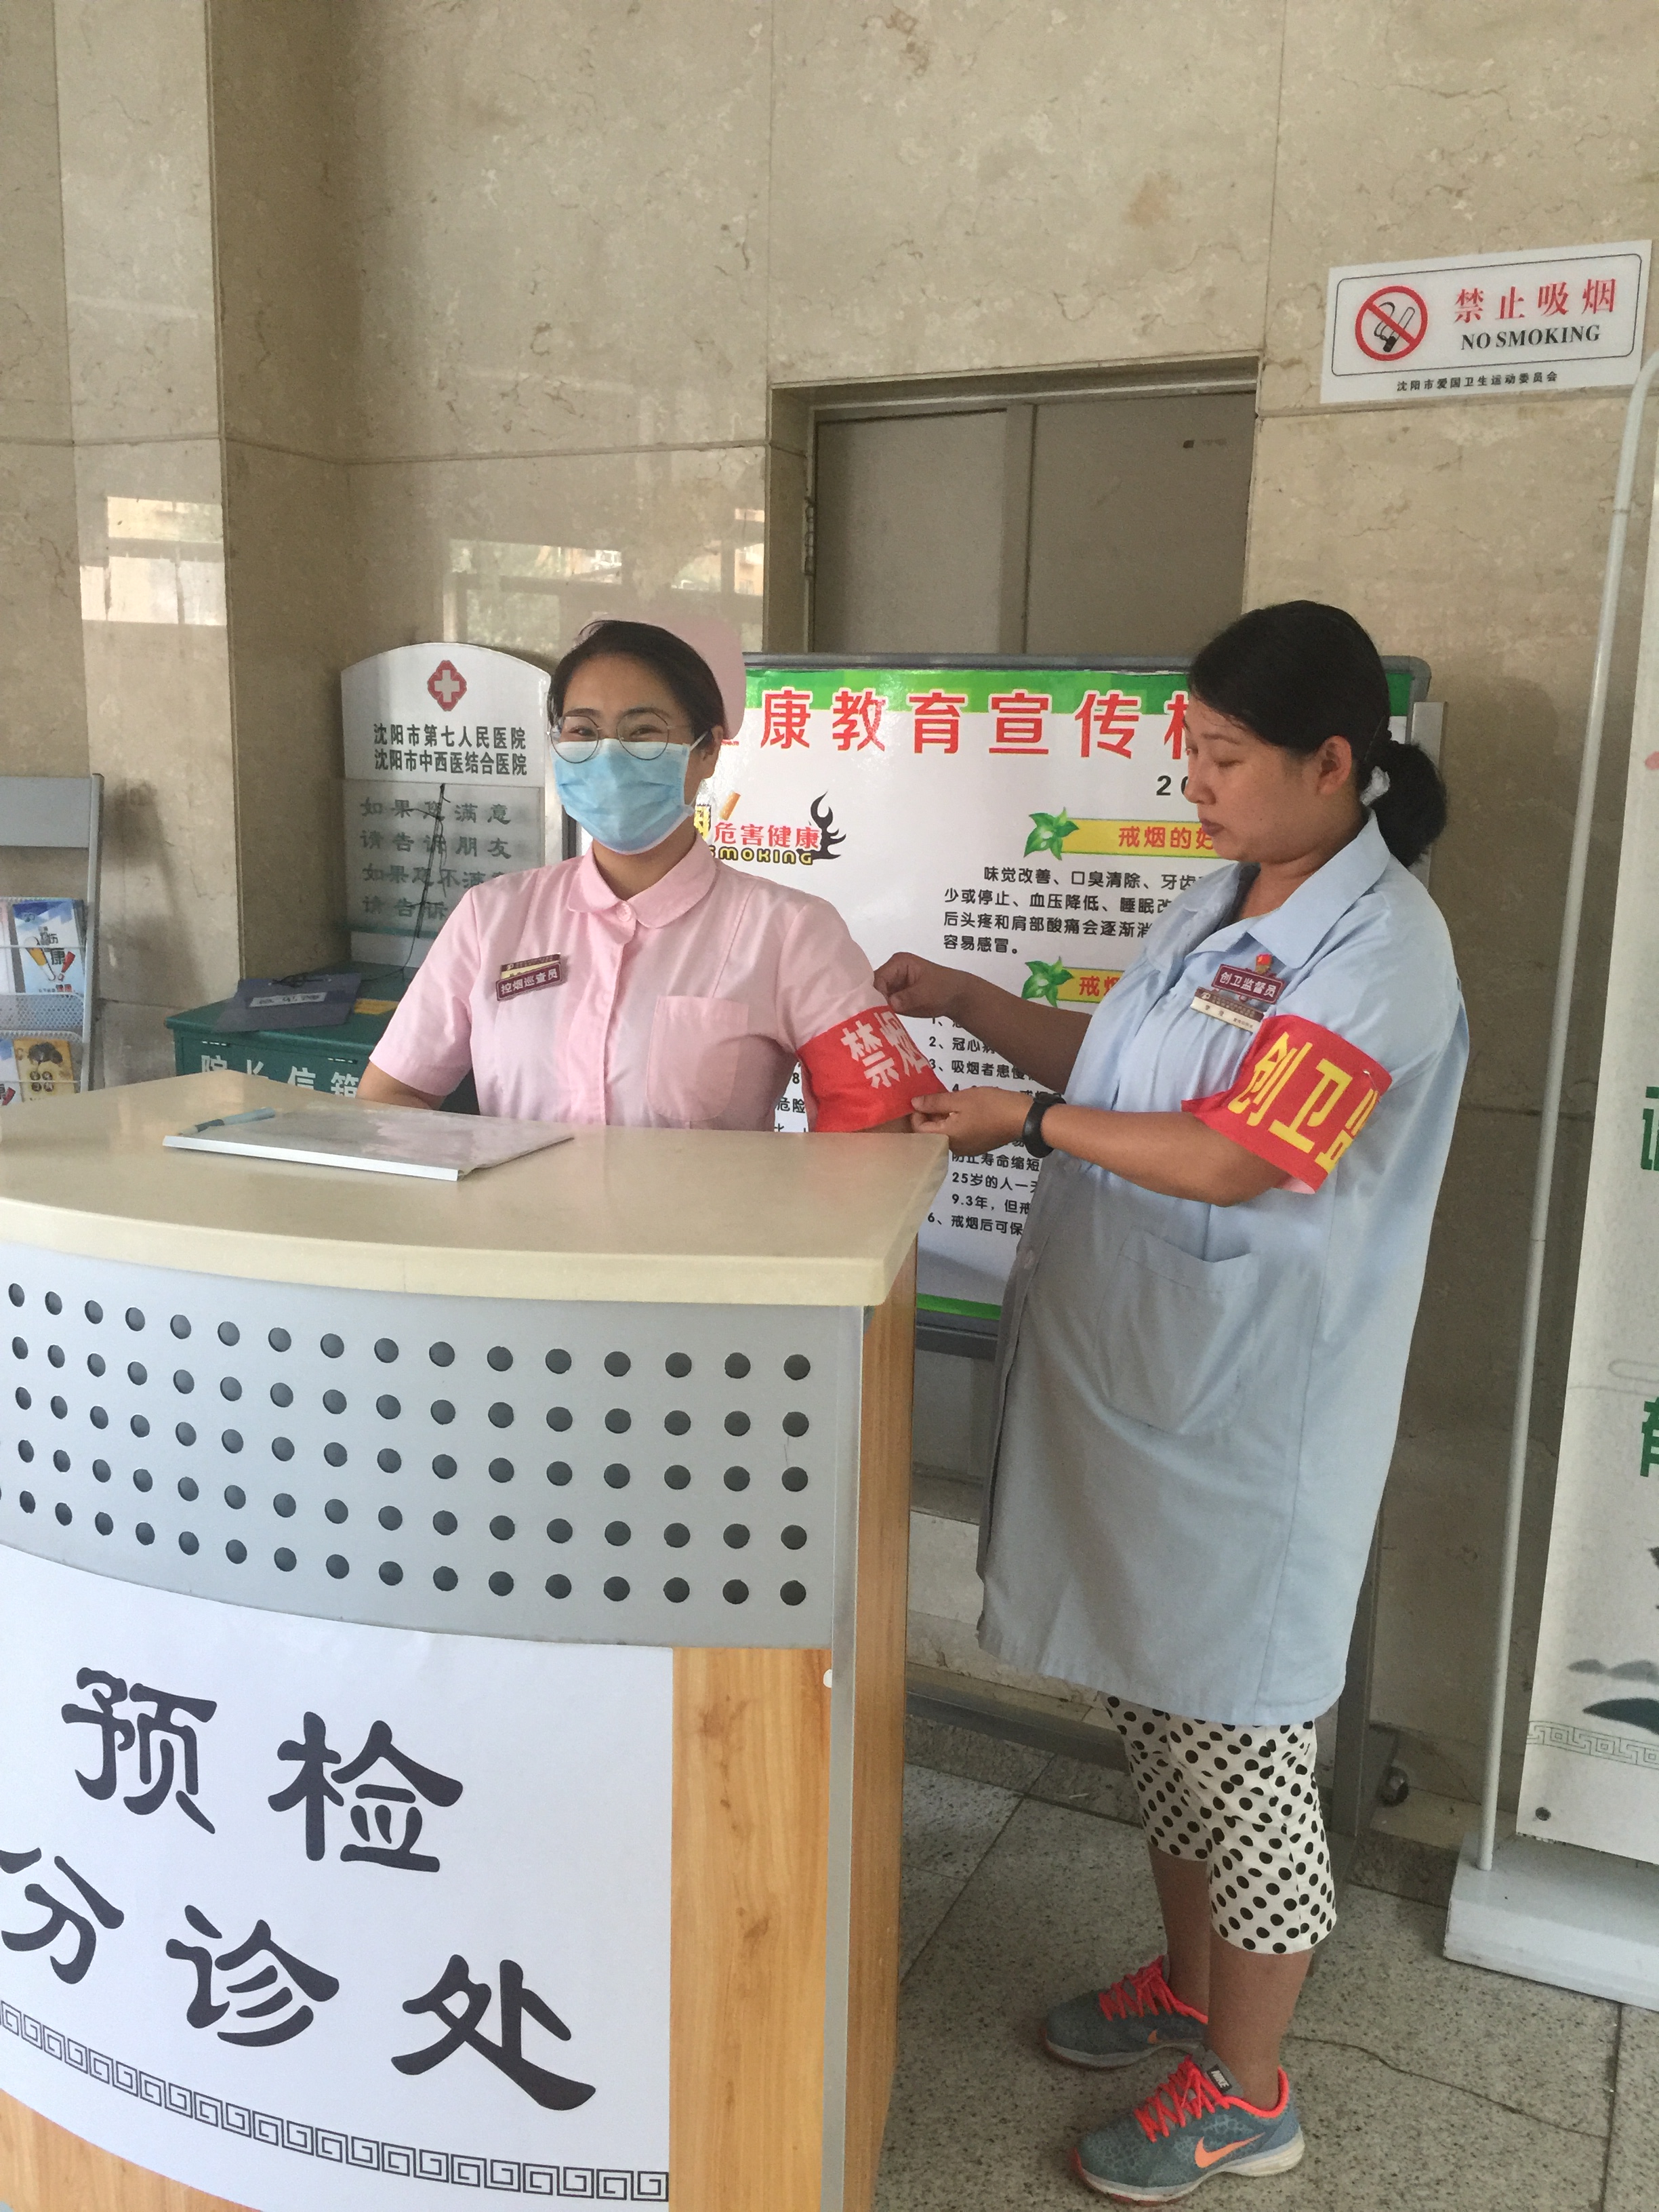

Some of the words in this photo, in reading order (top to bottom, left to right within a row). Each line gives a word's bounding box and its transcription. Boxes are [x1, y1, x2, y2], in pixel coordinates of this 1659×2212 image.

[1454, 278, 1616, 324] 禁止吸烟
[1461, 331, 1492, 350] NO
[1496, 324, 1601, 348] SMOKING
[1397, 371, 1558, 392] 沈阳市爱国卫生运动委员会
[373, 722, 527, 750] 沈阳市第七人民医院
[374, 749, 527, 776] 沈阳市中西医结合医院
[714, 821, 821, 850] 危害健康
[362, 862, 505, 889] 如果您不满
[943, 935, 1018, 955] 容易感冒。
[1220, 971, 1277, 998] 创卫监督员
[61, 1667, 464, 1873] 预检
[0, 1847, 596, 2111] 分诊处
